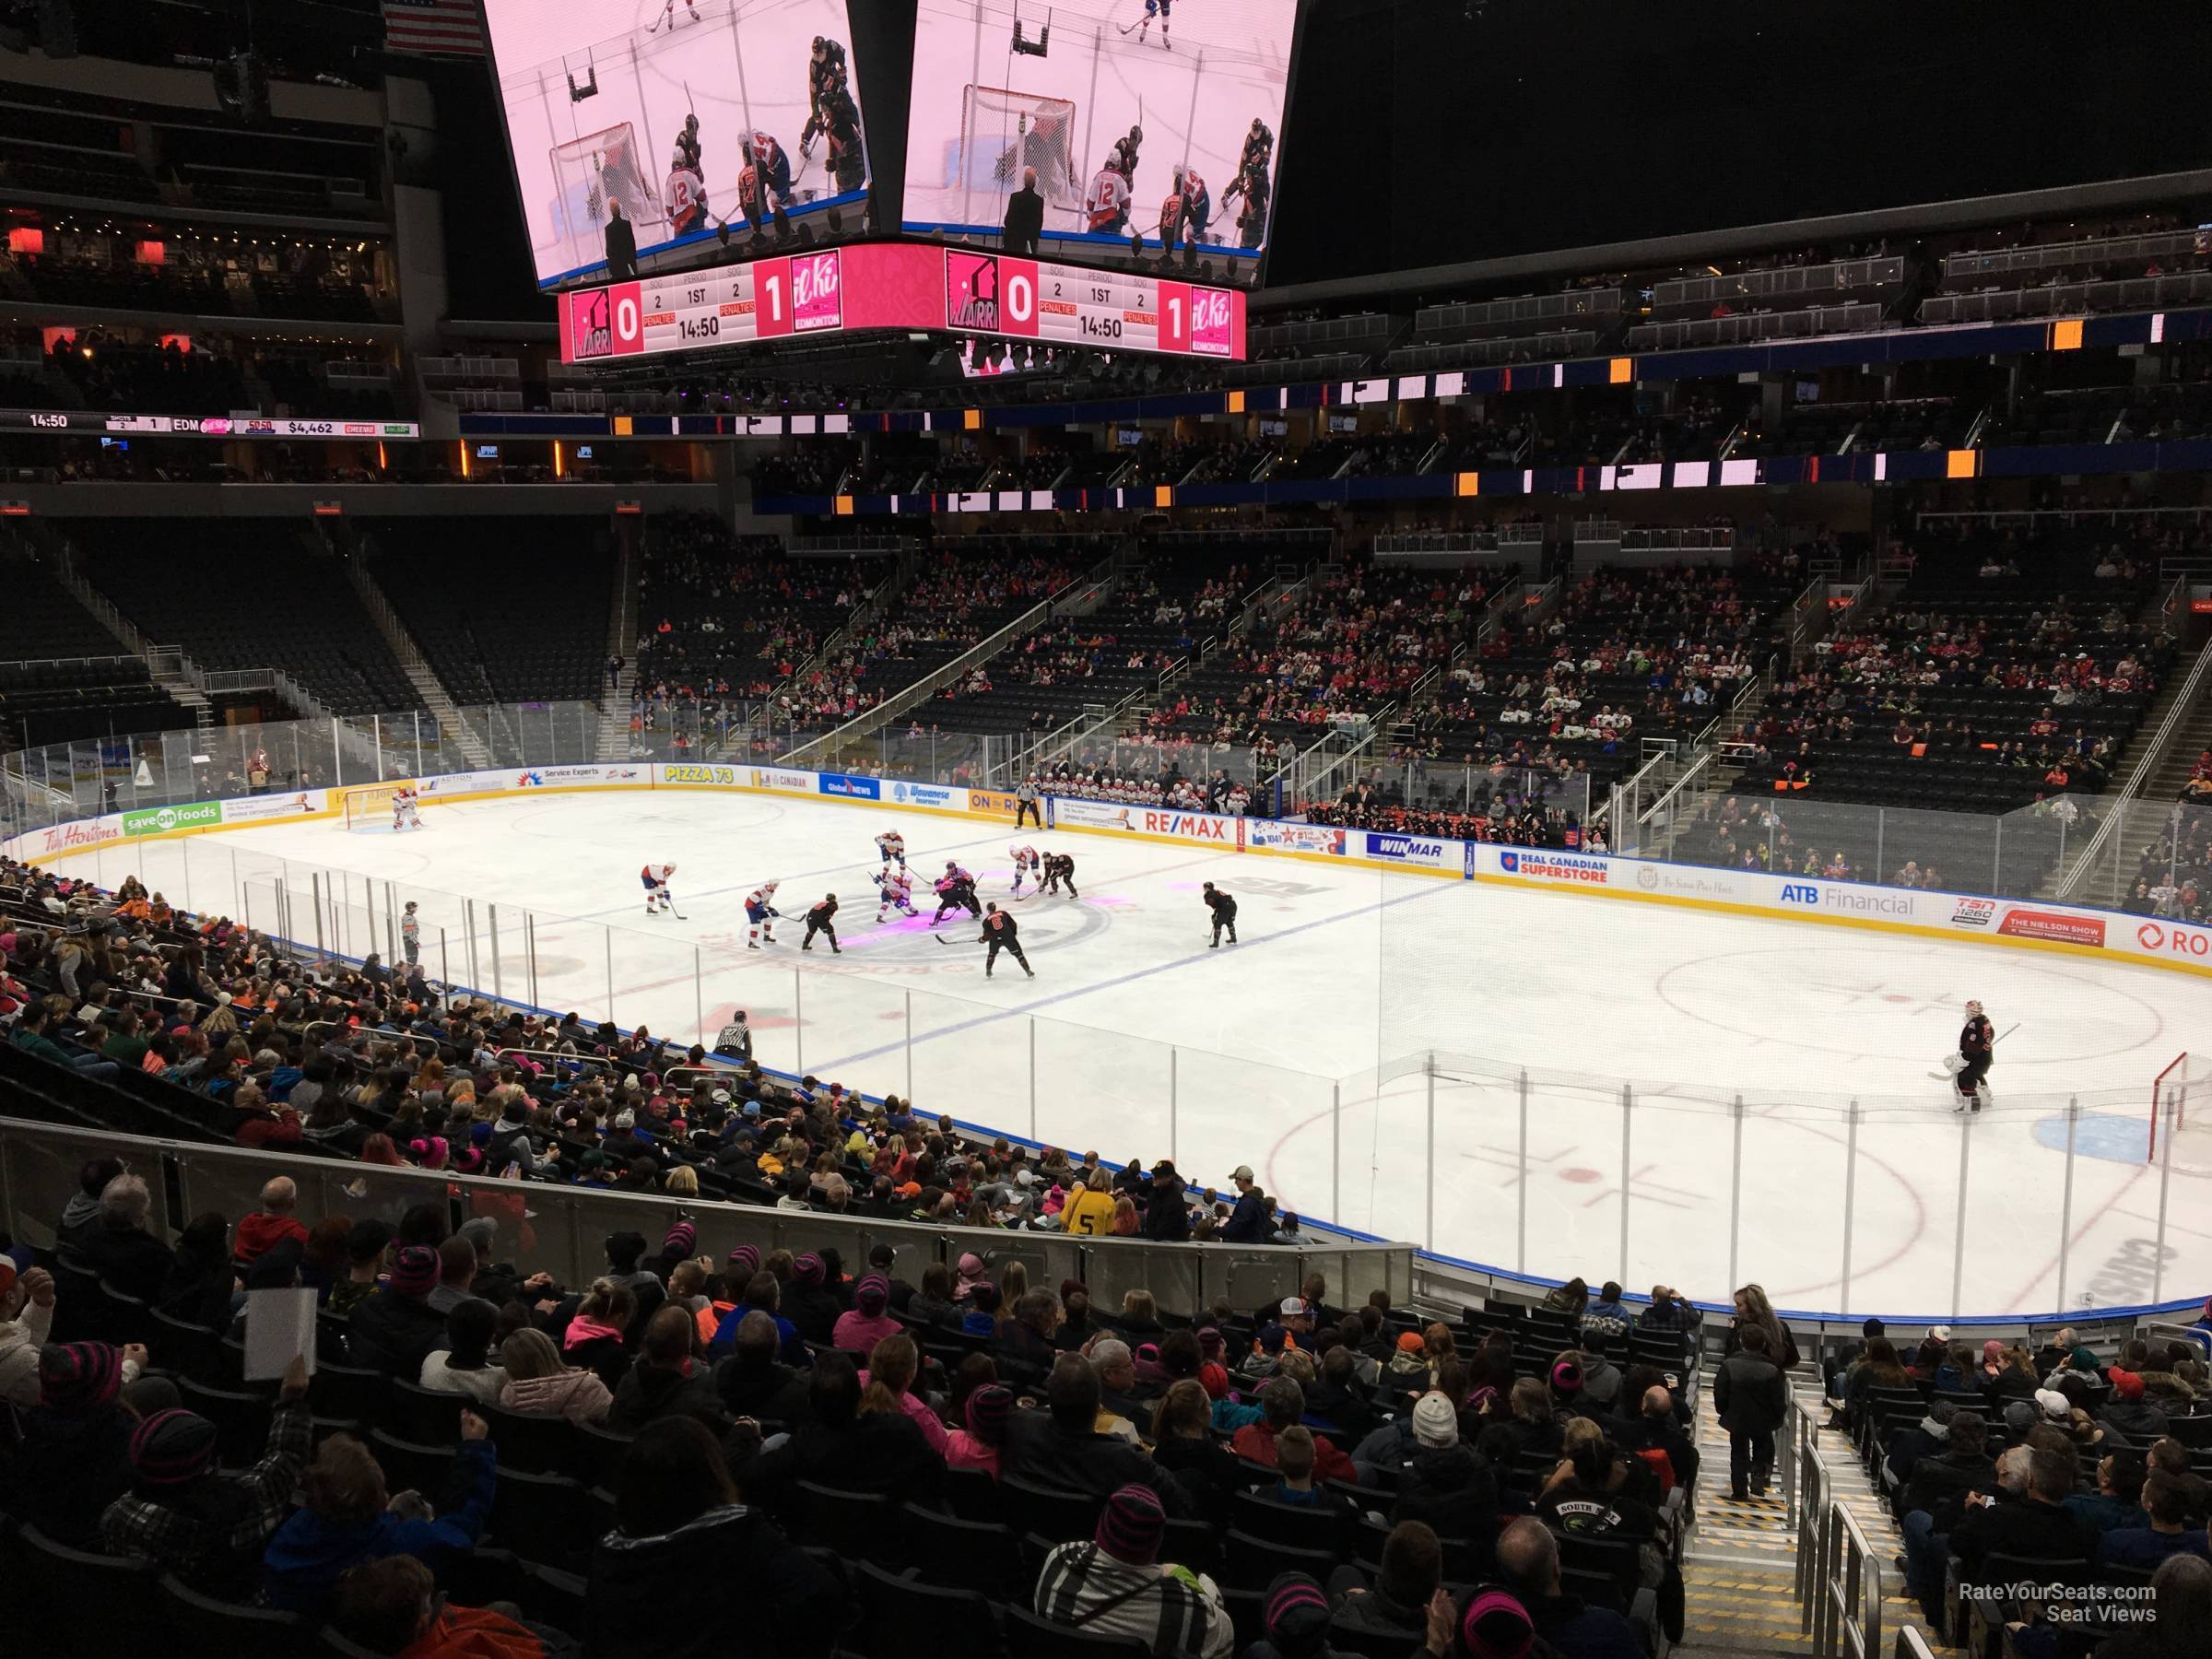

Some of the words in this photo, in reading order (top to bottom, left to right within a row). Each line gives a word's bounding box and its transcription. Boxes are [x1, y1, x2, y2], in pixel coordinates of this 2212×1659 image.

[674, 182, 688, 206] 12
[1098, 182, 1114, 206] 12
[1050, 265, 1065, 276] SOG
[1088, 271, 1112, 284] PERIOD
[650, 279, 664, 289] SOG
[684, 273, 707, 284] PERIOD
[688, 288, 706, 303] 1ST
[733, 284, 739, 297] 2
[1054, 283, 1061, 297] 2
[1091, 288, 1111, 303] 1ST
[655, 295, 661, 309] 2
[765, 276, 782, 321] 1
[1008, 276, 1032, 322] 0
[1137, 294, 1144, 307] 2
[720, 301, 755, 316] PENALTIES
[1040, 300, 1077, 315] PENALTIES
[618, 298, 638, 341] 0
[643, 313, 677, 326] PENALTIES
[795, 313, 840, 330] EDMONTON
[1124, 311, 1158, 325] PENALTIES
[1168, 298, 1181, 338] 1
[679, 316, 719, 340] 14:50
[1081, 315, 1122, 338] 14:50
[1193, 341, 1230, 354] EDMONTON
[30, 415, 67, 428] 14:50
[151, 418, 157, 429] 1
[174, 419, 199, 431] EDM
[288, 422, 333, 435] $4,462
[545, 770, 571, 778] Service
[573, 768, 599, 778] Experts
[665, 766, 713, 782] PIZZA
[715, 768, 734, 783] 73
[781, 775, 806, 788] CANADIAN
[828, 783, 848, 793] Global
[852, 786, 871, 795] NEWS
[910, 785, 949, 800] Wawanesa
[915, 797, 940, 806] Insurance
[972, 794, 990, 809] ON
[128, 816, 157, 830] save
[177, 806, 216, 821] foods
[1146, 811, 1225, 839] RE/MAX
[1380, 839, 1442, 857] WINMAR
[1522, 854, 1547, 865] REAL
[1550, 856, 1607, 871] CANADIAN
[1522, 865, 1606, 883] SUPERSTORE
[1781, 884, 1818, 904] ATB
[1825, 888, 1913, 915] Financial
[1958, 898, 1995, 911] TSN
[1960, 909, 1993, 918] 1260
[2010, 918, 2029, 926] THE
[2030, 921, 2069, 932] NIELSON
[2071, 925, 2099, 935] SHOW
[1080, 1214, 1094, 1234] 5
[1560, 1503, 1593, 1513] SOUTH
